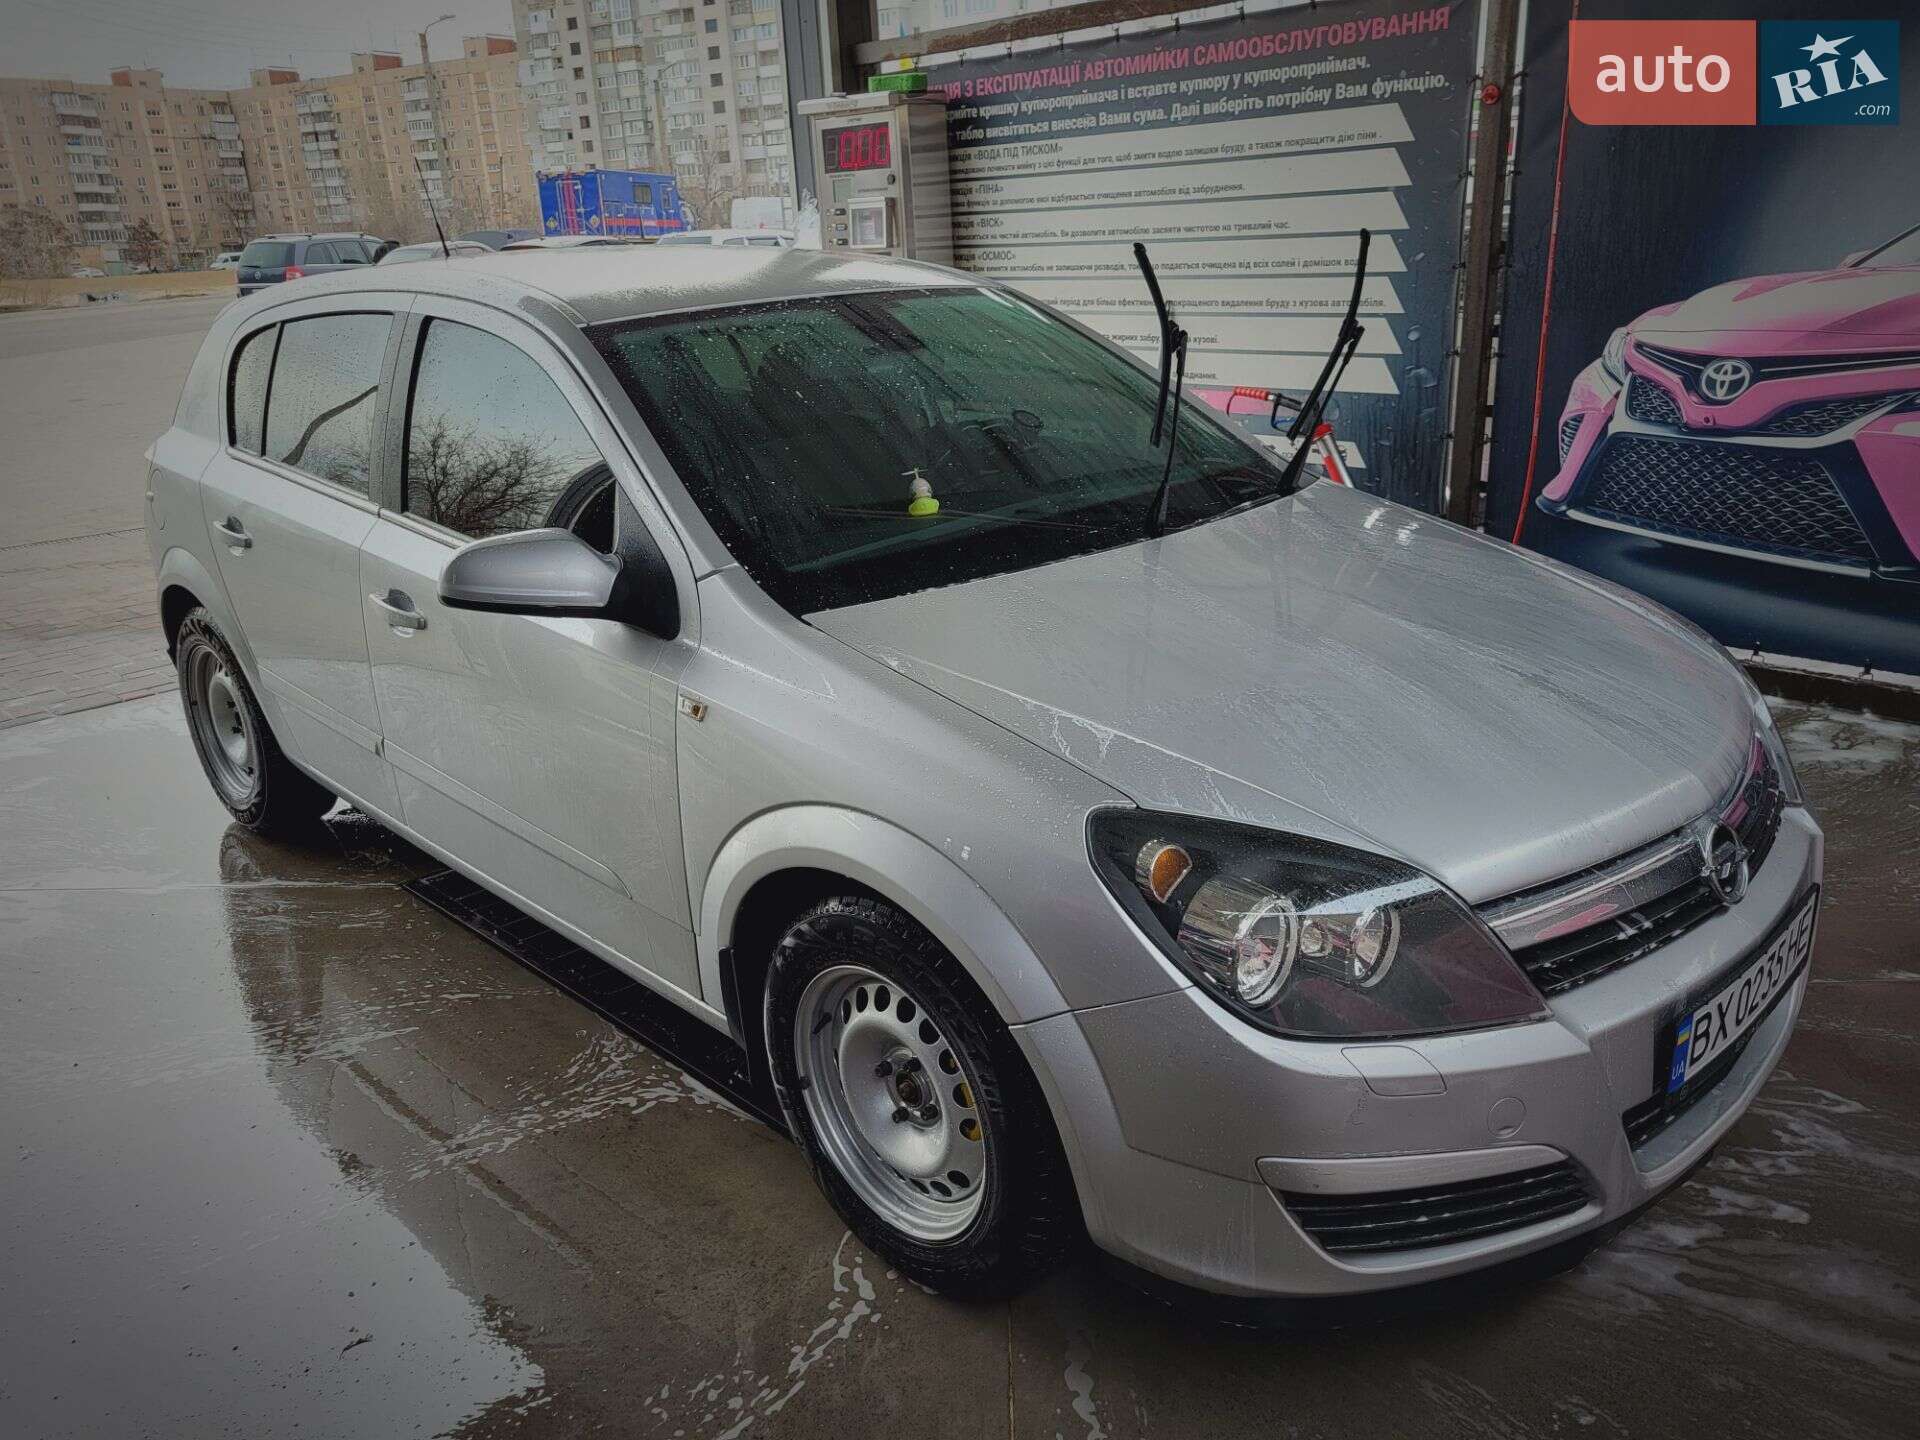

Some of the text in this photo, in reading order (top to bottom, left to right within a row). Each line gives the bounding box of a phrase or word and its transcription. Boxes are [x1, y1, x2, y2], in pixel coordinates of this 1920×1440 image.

[964, 82, 973, 97] З
[976, 61, 1080, 97] ЕКСПЛУАТАЦІЇ
[1083, 46, 1189, 82] АВТОМИЙКИ
[1194, 6, 1450, 66] САМООБСЛУГОВУВАННЯ
[980, 102, 1019, 120] кришку
[1021, 90, 1118, 116] купюроприймача
[1127, 82, 1177, 99] вставте
[1179, 74, 1230, 95] купюру
[1232, 73, 1241, 90] у
[1244, 56, 1371, 87] купюроприймач.
[956, 71, 1450, 141] табло висвітиться внесена Вами сума. Далі виберіть потрібну Вам функцію.
[1255, 140, 1282, 150] також
[1284, 136, 1336, 148] покращити
[1337, 132, 1355, 144] дію
[1003, 146, 1020, 159] ПІД
[1234, 220, 1272, 232] тривалий
[1238, 258, 1251, 270] від
[1271, 257, 1296, 268] солей
[1303, 256, 1341, 268] домішок
[1265, 297, 1290, 309] бруду
[1331, 297, 1386, 308] автообіля.
[1671, 1065, 1685, 1080] UA
